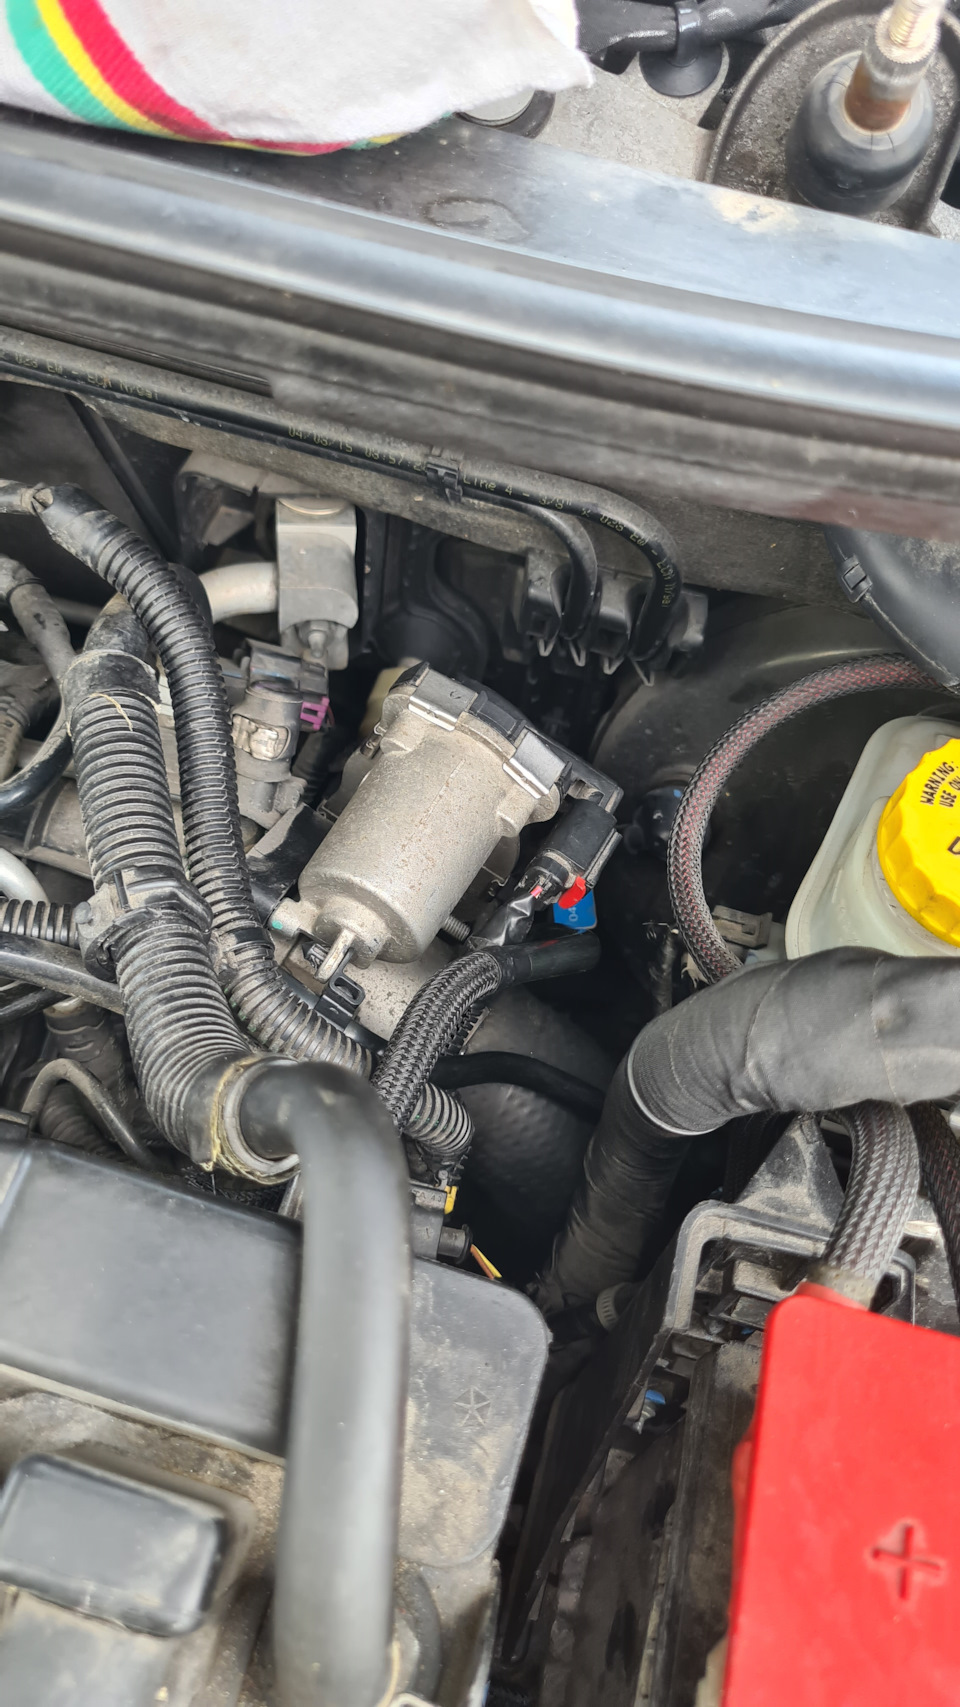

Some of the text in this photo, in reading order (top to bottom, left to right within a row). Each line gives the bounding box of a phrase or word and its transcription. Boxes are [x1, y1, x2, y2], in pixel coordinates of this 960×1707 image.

[463, 474, 496, 491] Line
[504, 485, 513, 496] 4
[919, 761, 960, 806] WARNING:
[938, 789, 958, 808] USE
